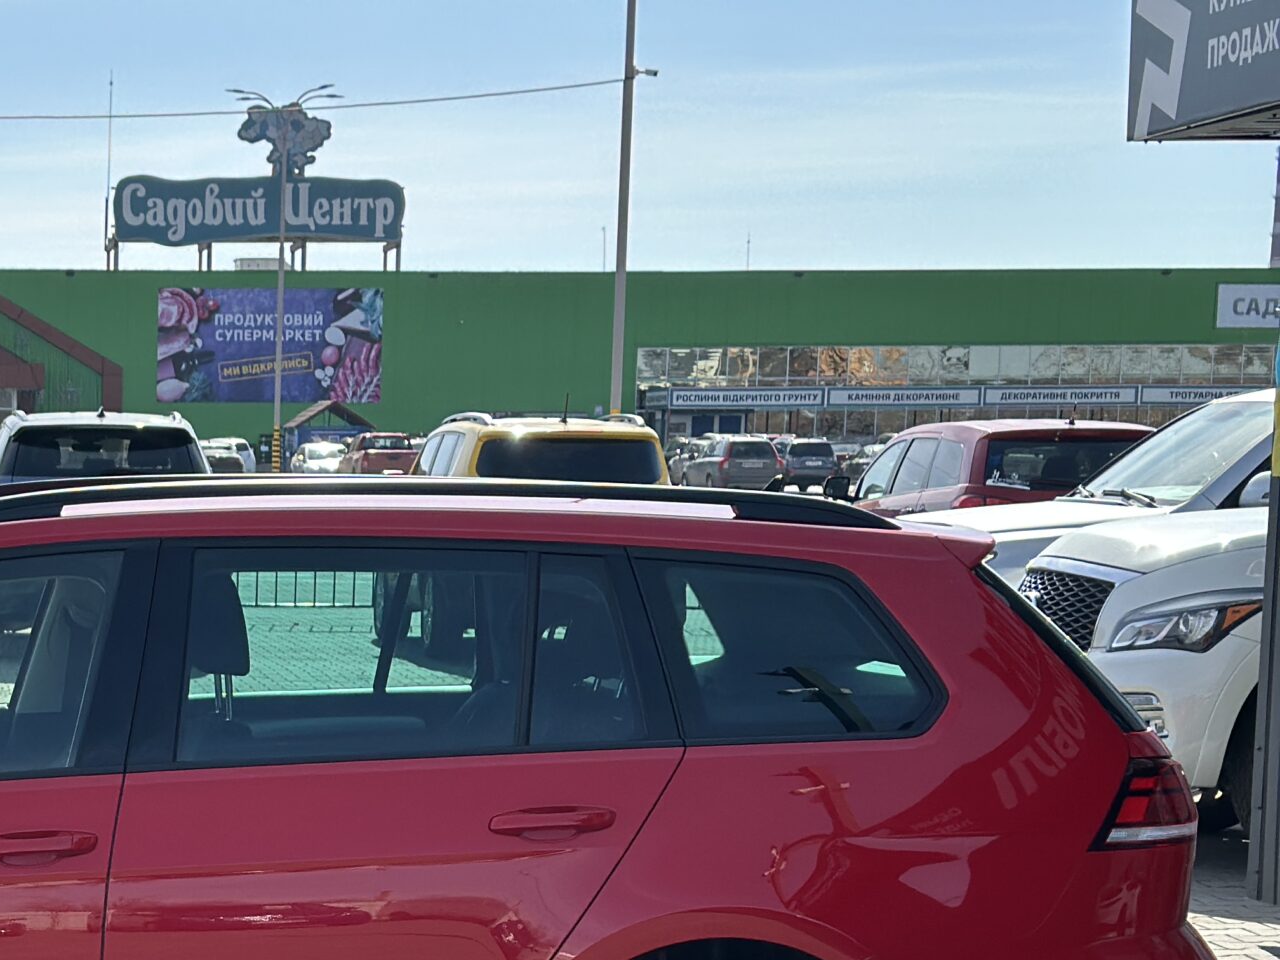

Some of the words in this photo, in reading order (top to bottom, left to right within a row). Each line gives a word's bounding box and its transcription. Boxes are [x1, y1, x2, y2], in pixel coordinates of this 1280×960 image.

[121, 182, 267, 242] Садовий
[284, 182, 395, 238] Центр
[214, 311, 324, 327] ПРОДУКОВИЙ
[223, 366, 241, 377] МИ
[676, 393, 720, 403] РОСЛИНИ
[722, 393, 781, 403] ВІДКРИТОГО
[847, 392, 891, 402] КАМІННЯ
[892, 392, 961, 402] ДЕКОРАТИВНЕ
[1000, 391, 1068, 401] ДЕКОРАТИВНЕ
[1070, 391, 1120, 400] ПОКРИТТЯ
